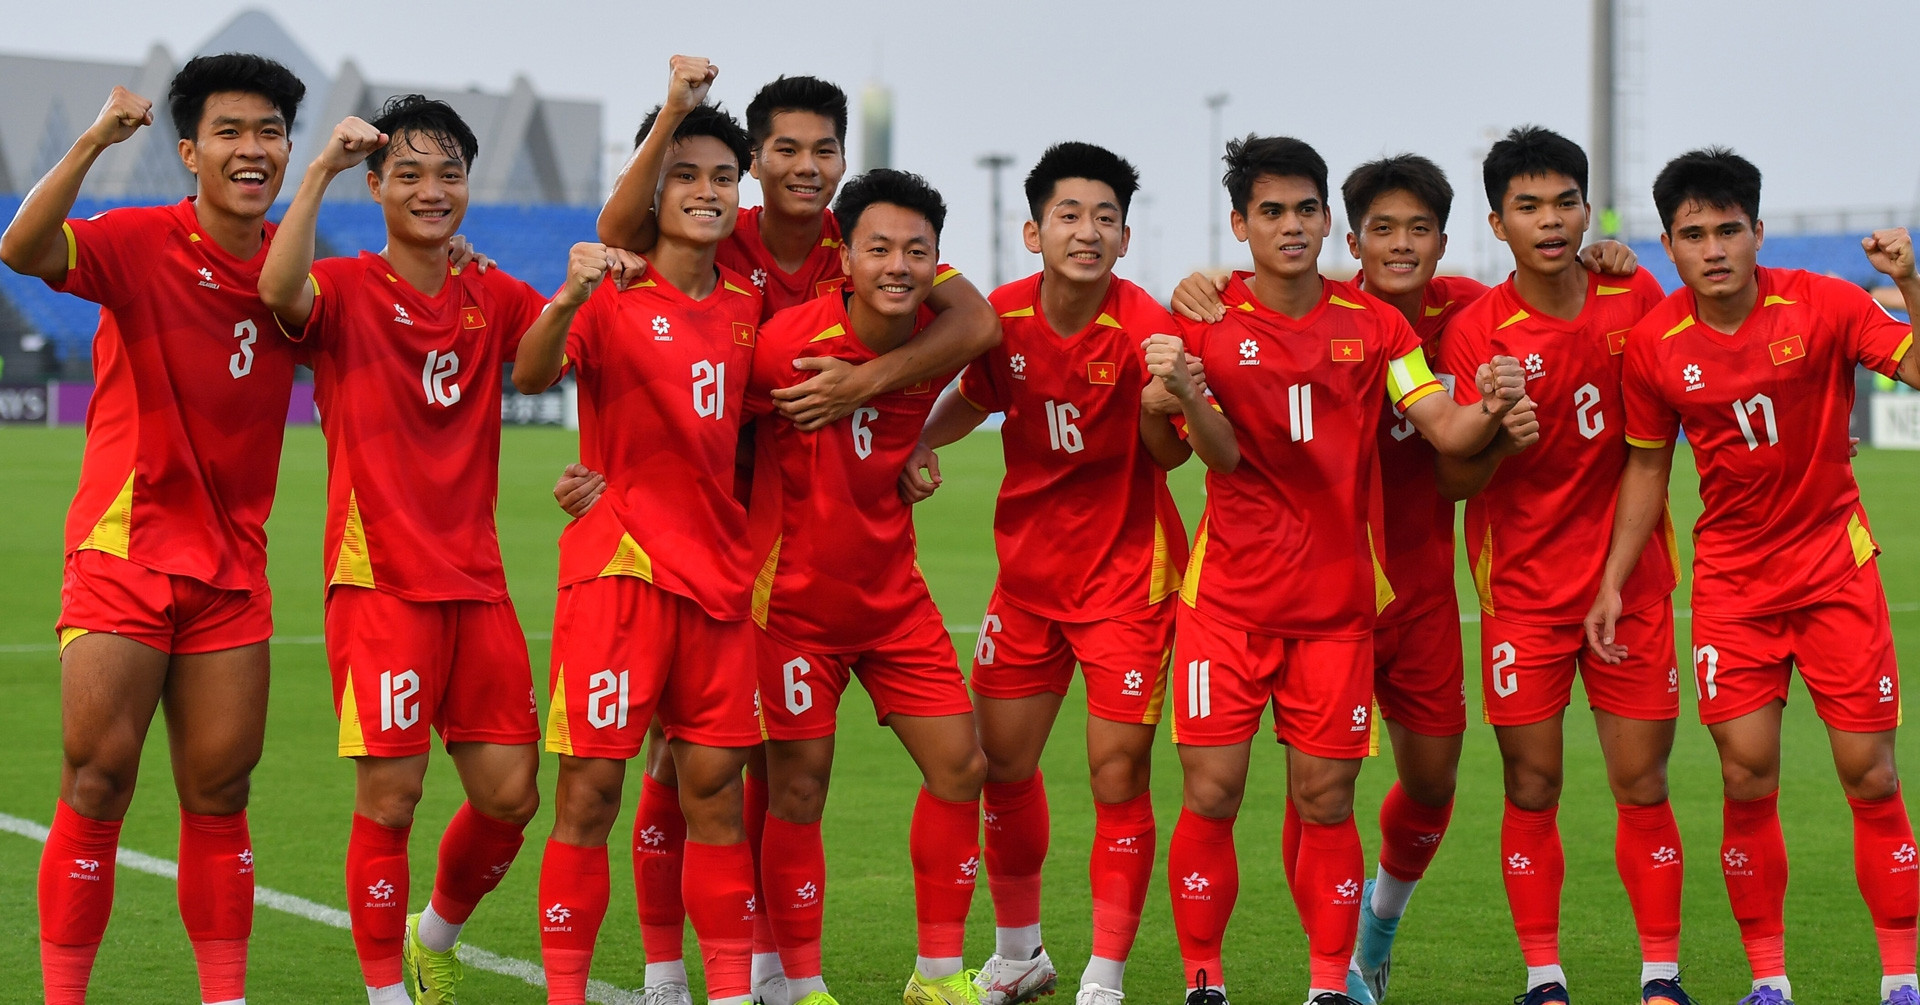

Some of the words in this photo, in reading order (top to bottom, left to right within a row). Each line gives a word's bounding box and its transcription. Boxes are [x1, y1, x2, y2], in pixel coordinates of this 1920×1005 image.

[228, 318, 258, 380] 3
[422, 349, 461, 408] 12
[691, 359, 725, 421] 21
[1288, 383, 1314, 443] 11
[1573, 382, 1605, 440] 2
[851, 407, 879, 461] 6
[1044, 399, 1085, 454] 16
[1732, 392, 1779, 452] 17
[587, 669, 629, 730] 21
[782, 656, 813, 716] 6
[1188, 659, 1211, 719] 11
[1492, 641, 1518, 699] 2
[380, 669, 420, 732] 12
